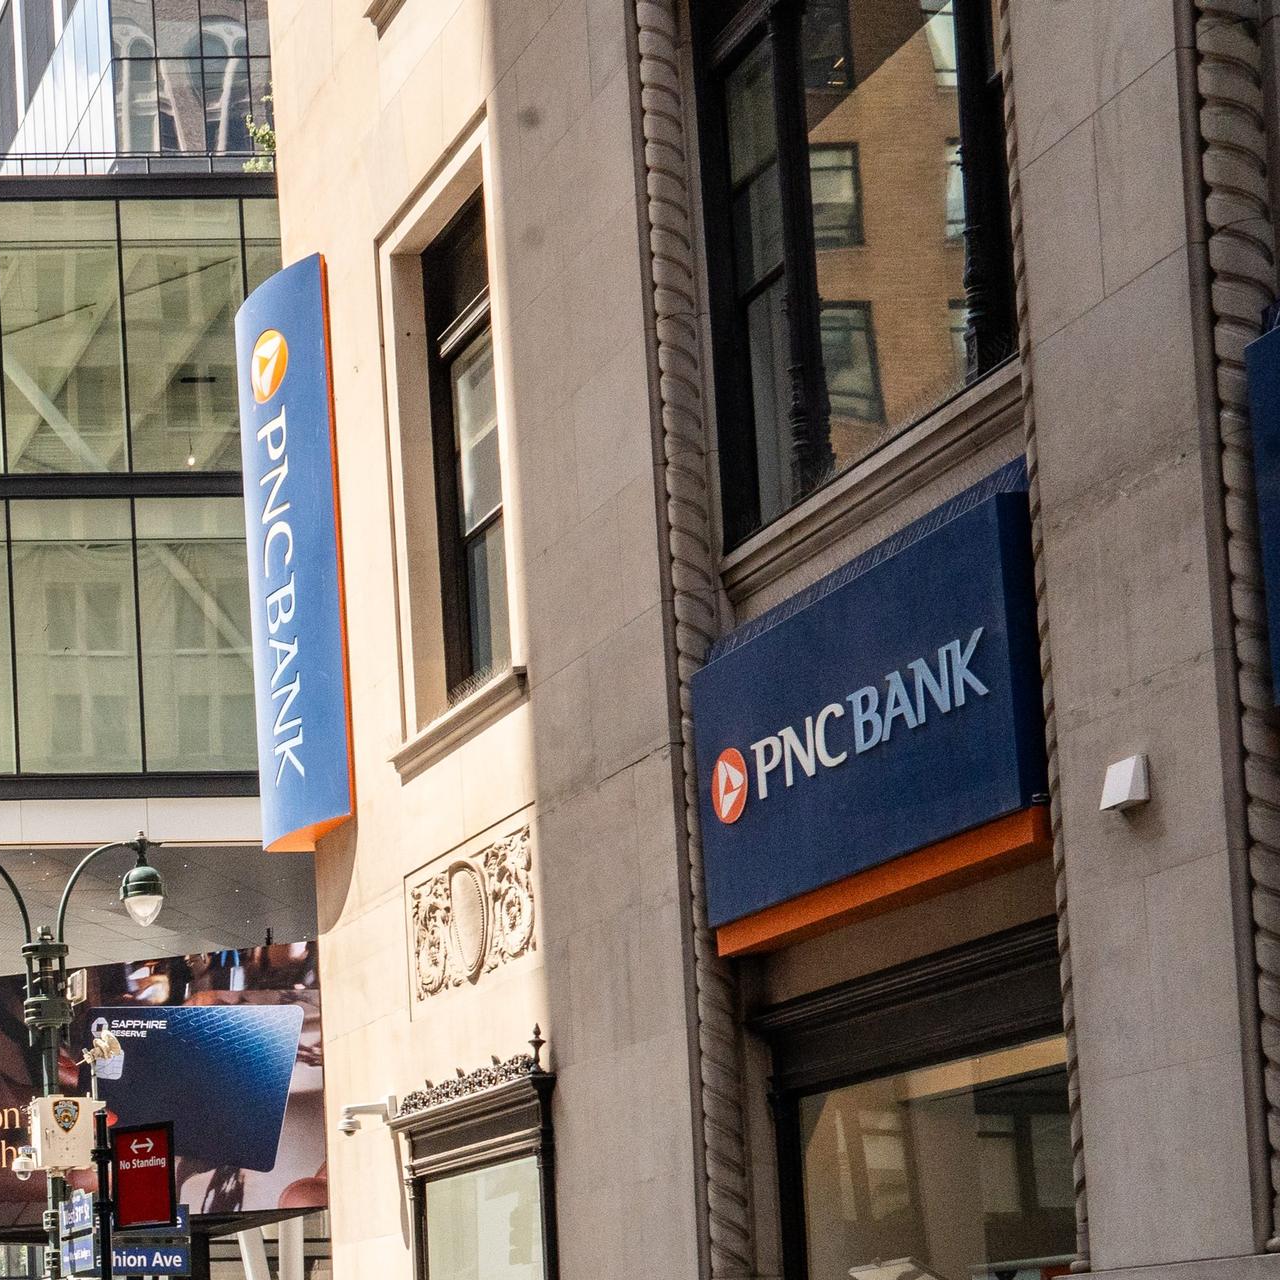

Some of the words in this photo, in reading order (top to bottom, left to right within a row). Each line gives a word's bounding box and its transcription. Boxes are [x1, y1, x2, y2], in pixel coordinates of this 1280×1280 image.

[111, 1020, 167, 1029] SAPPHIRE
[120, 1160, 131, 1170] No
[132, 1156, 167, 1168] Standing
[96, 1250, 147, 1267] ahion
[152, 1252, 182, 1267] Ave
